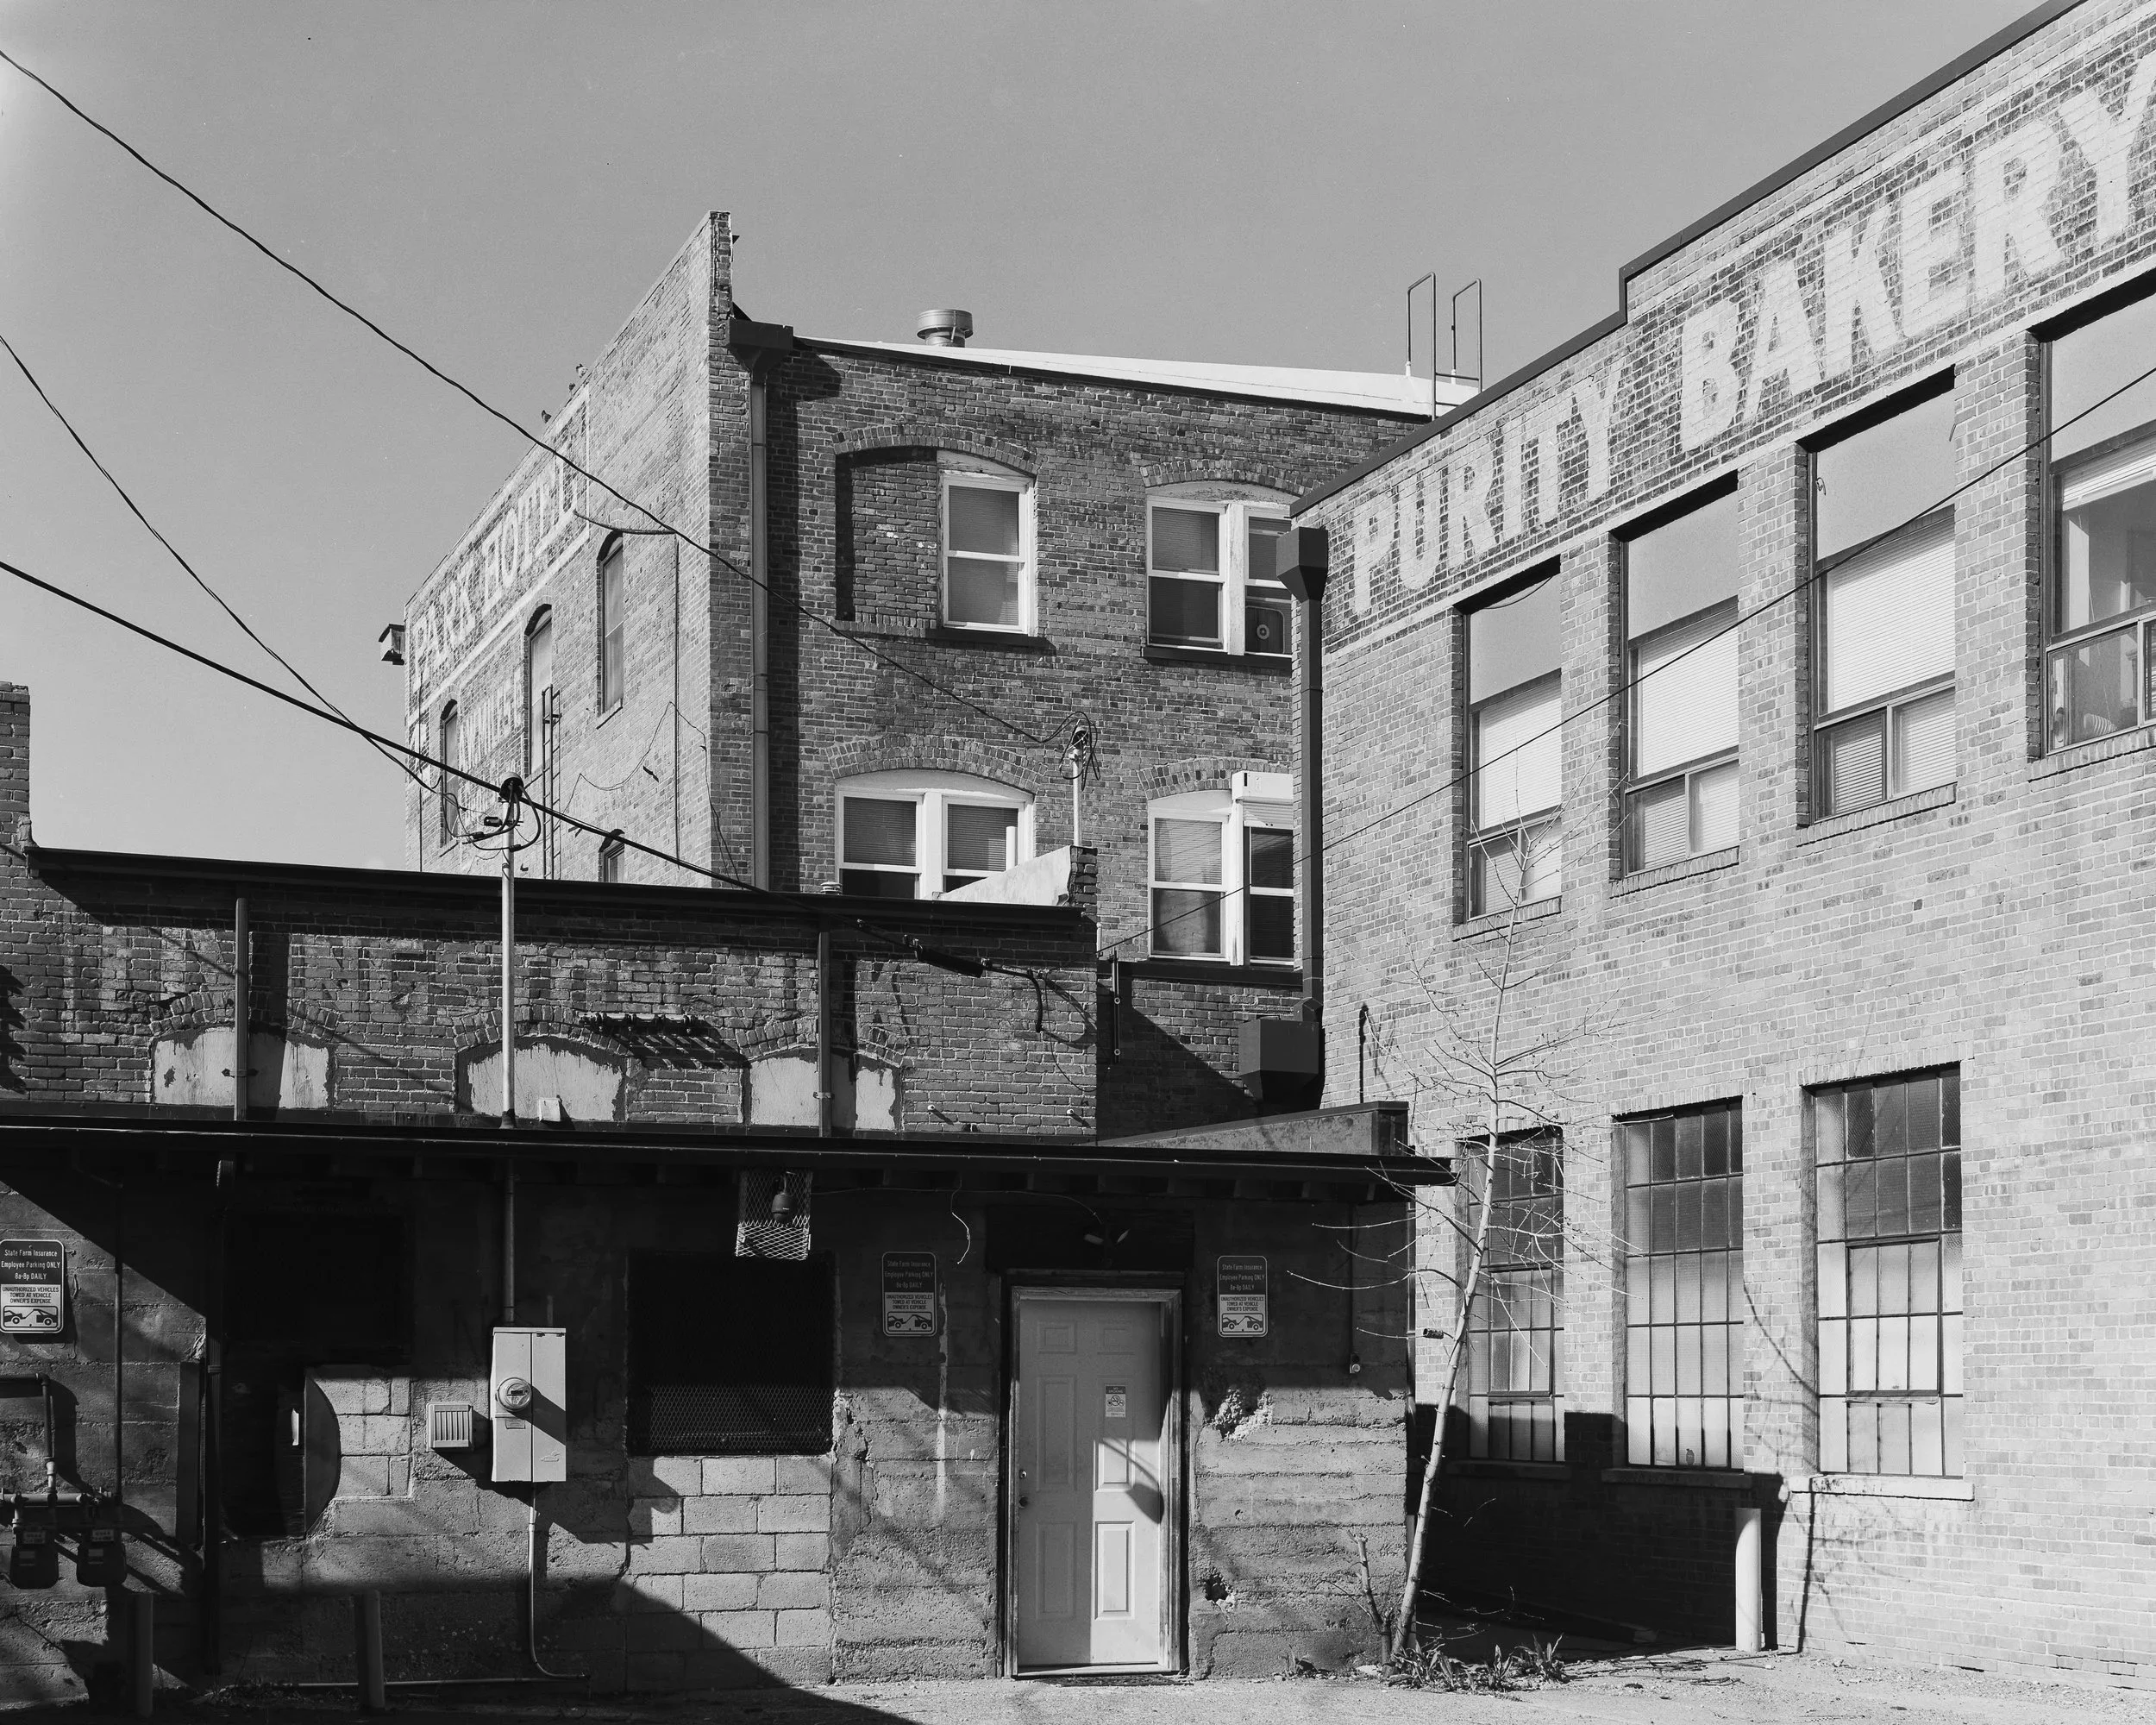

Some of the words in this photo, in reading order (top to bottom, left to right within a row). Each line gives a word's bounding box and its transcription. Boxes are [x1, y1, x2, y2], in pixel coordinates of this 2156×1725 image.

[1345, 362, 1630, 614] PURITY
[1680, 57, 2156, 452] BAKERY
[411, 555, 477, 693] PARK
[1, 1261, 25, 1270] Employee
[26, 1261, 47, 1270] Parking
